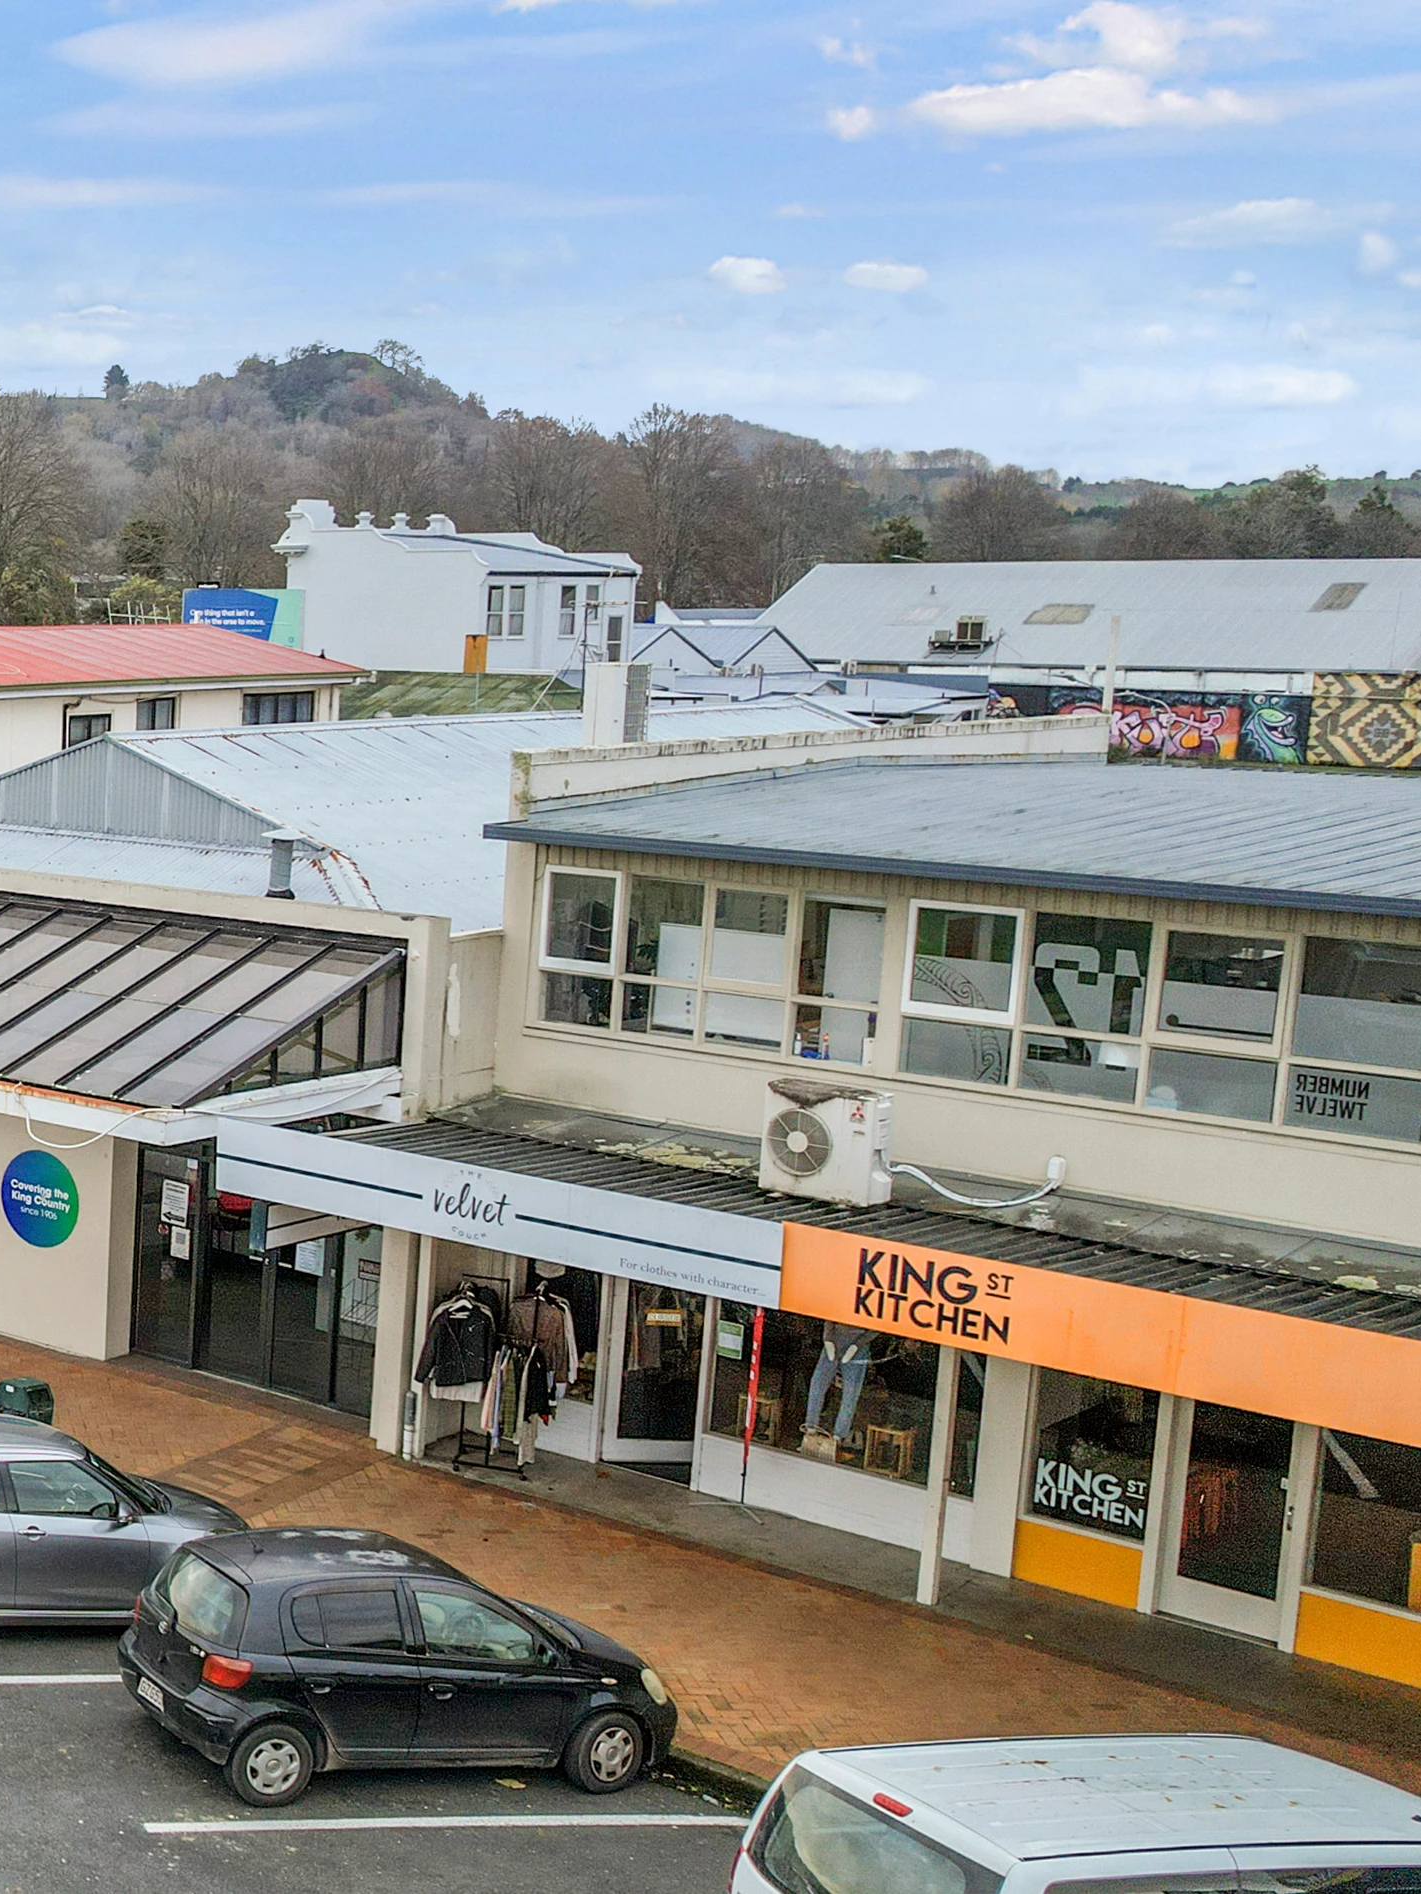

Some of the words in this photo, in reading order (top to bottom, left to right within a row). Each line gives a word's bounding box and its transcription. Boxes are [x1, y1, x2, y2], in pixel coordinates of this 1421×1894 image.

[222, 609, 235, 617] that
[460, 1169, 482, 1179] THE
[10, 1178, 52, 1198] Covering
[54, 1187, 69, 1200] the
[11, 1189, 32, 1205] King
[34, 1195, 70, 1214] Country
[20, 1205, 39, 1216] since
[40, 1208, 58, 1220] 1906
[434, 1182, 512, 1226] velvet
[451, 1225, 487, 1239] COUCH
[619, 1257, 638, 1270] For
[640, 1260, 678, 1279] clothes
[680, 1271, 705, 1285] with
[857, 1247, 978, 1305] KING
[987, 1272, 1015, 1293] ST
[854, 1285, 1010, 1346] KITCHEN
[1036, 1457, 1123, 1501] KING
[1126, 1479, 1147, 1495] ST
[1033, 1483, 1146, 1530] KITCHEN
